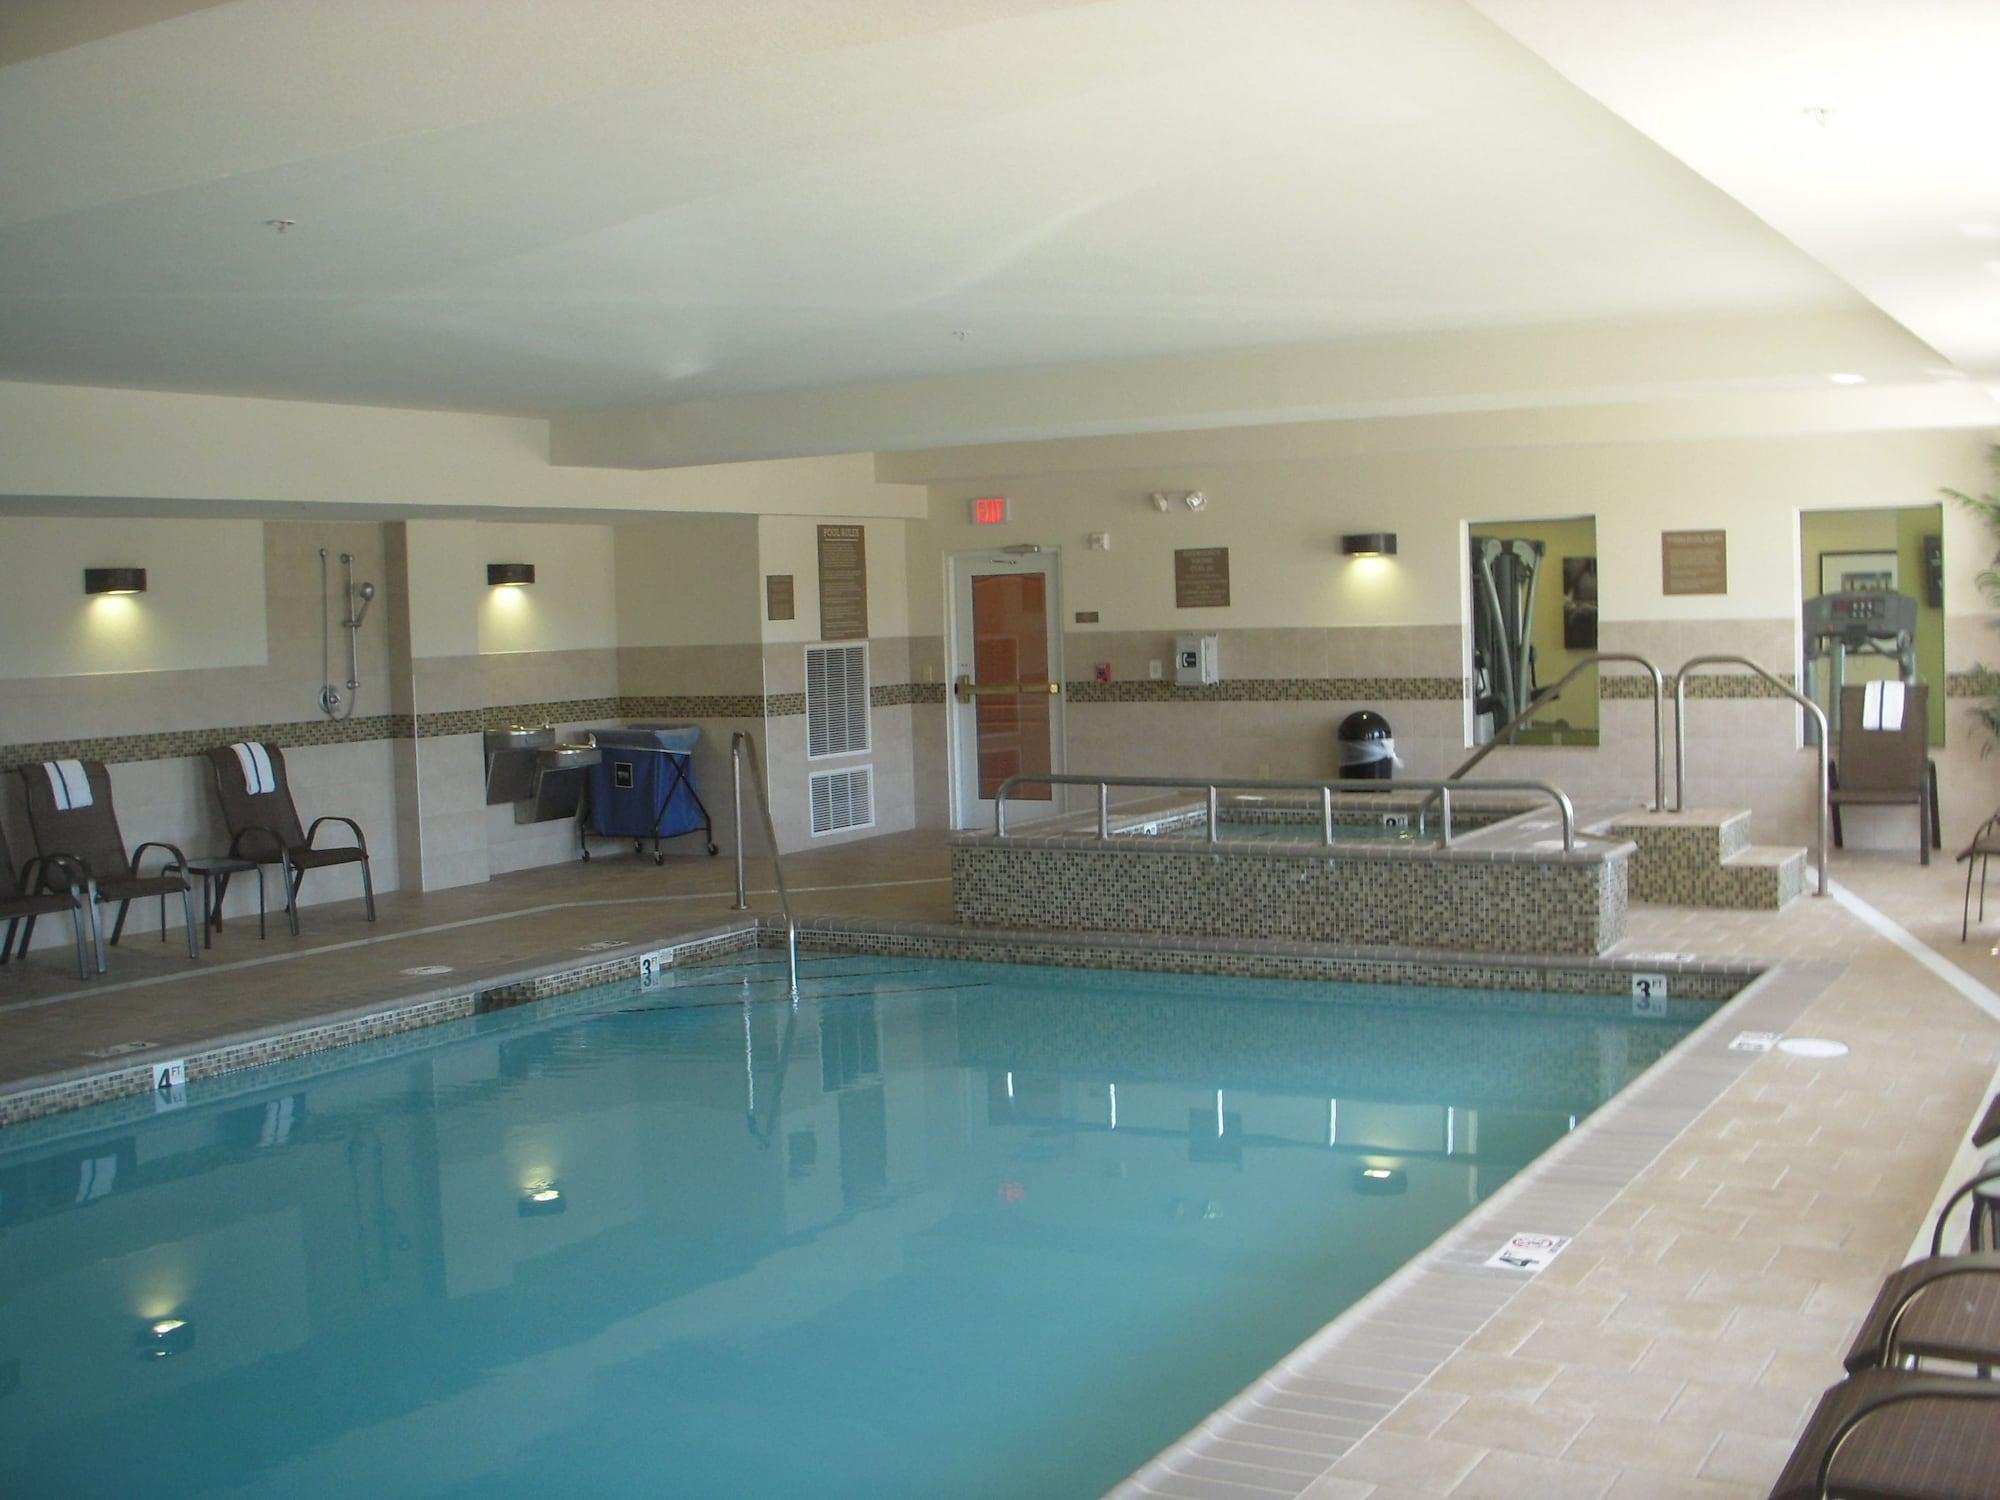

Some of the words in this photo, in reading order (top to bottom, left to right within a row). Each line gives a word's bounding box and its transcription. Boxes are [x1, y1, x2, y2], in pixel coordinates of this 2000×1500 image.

[976, 498, 1003, 523] EXIT
[824, 528, 840, 537] POOL
[643, 959, 652, 975] 3
[1636, 980, 1651, 998] 3
[158, 1067, 172, 1089] 4
